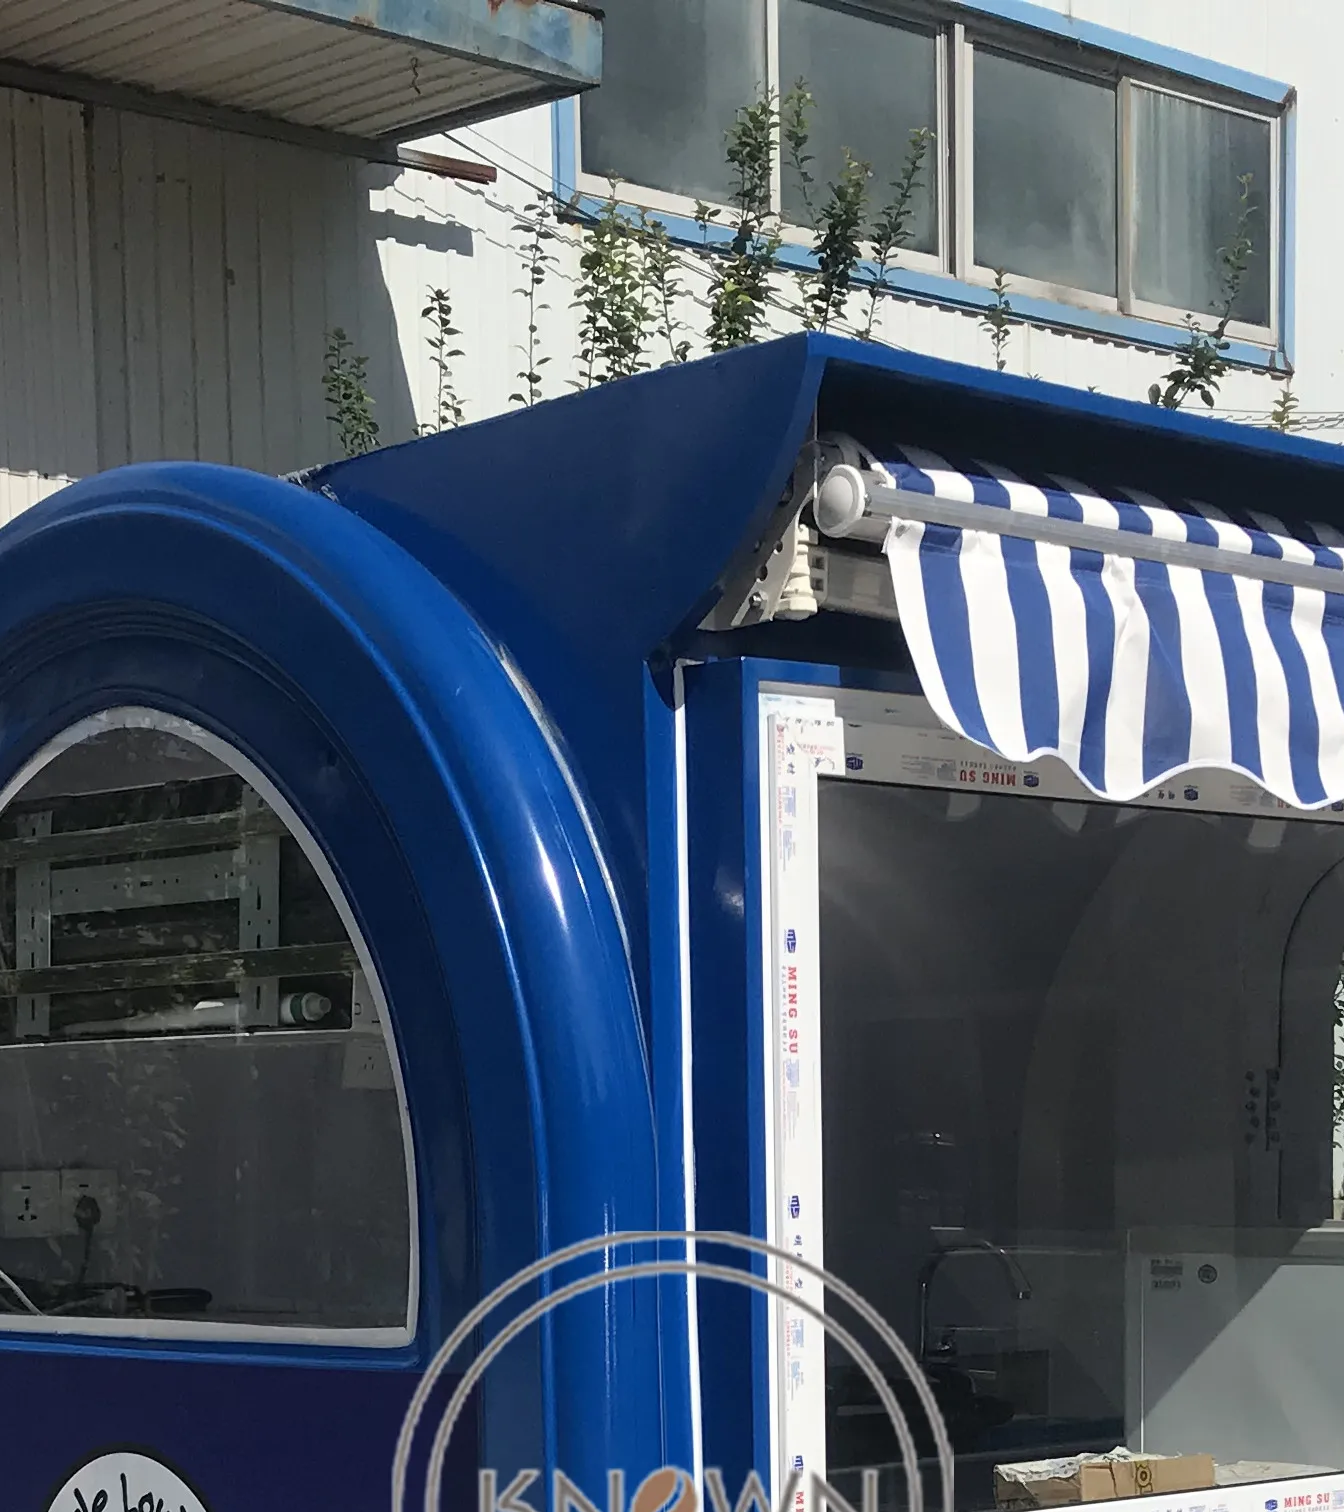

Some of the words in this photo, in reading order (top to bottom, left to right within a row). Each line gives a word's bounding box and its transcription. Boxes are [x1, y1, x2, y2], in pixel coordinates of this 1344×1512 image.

[788, 966, 798, 1018] MING
[788, 1029, 799, 1054] SU
[1284, 1494, 1312, 1508] MING
[1316, 1492, 1330, 1505] SU
